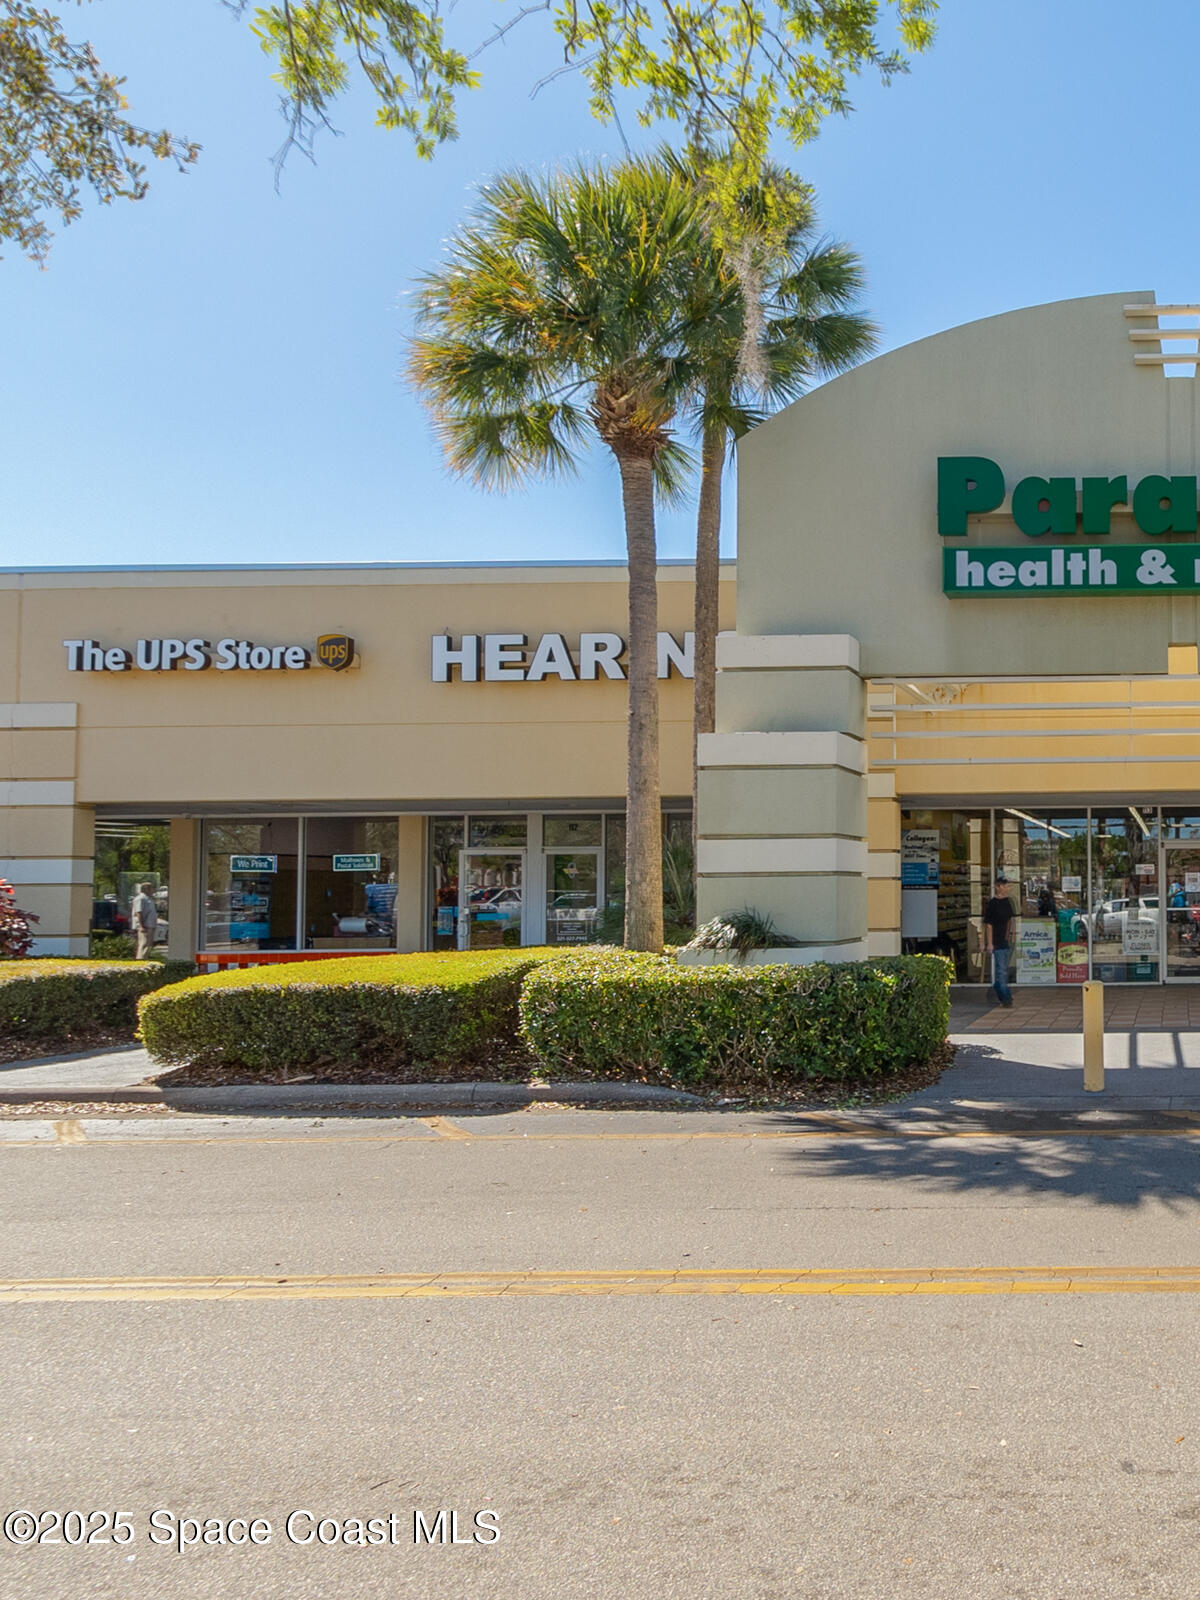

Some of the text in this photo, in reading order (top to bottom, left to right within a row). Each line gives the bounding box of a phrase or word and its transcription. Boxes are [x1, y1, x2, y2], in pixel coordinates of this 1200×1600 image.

[955, 547, 1118, 587] health
[1135, 549, 1178, 585] &
[63, 638, 307, 671] The UPS Store
[319, 642, 347, 667] ups
[431, 631, 696, 683] HEARN
